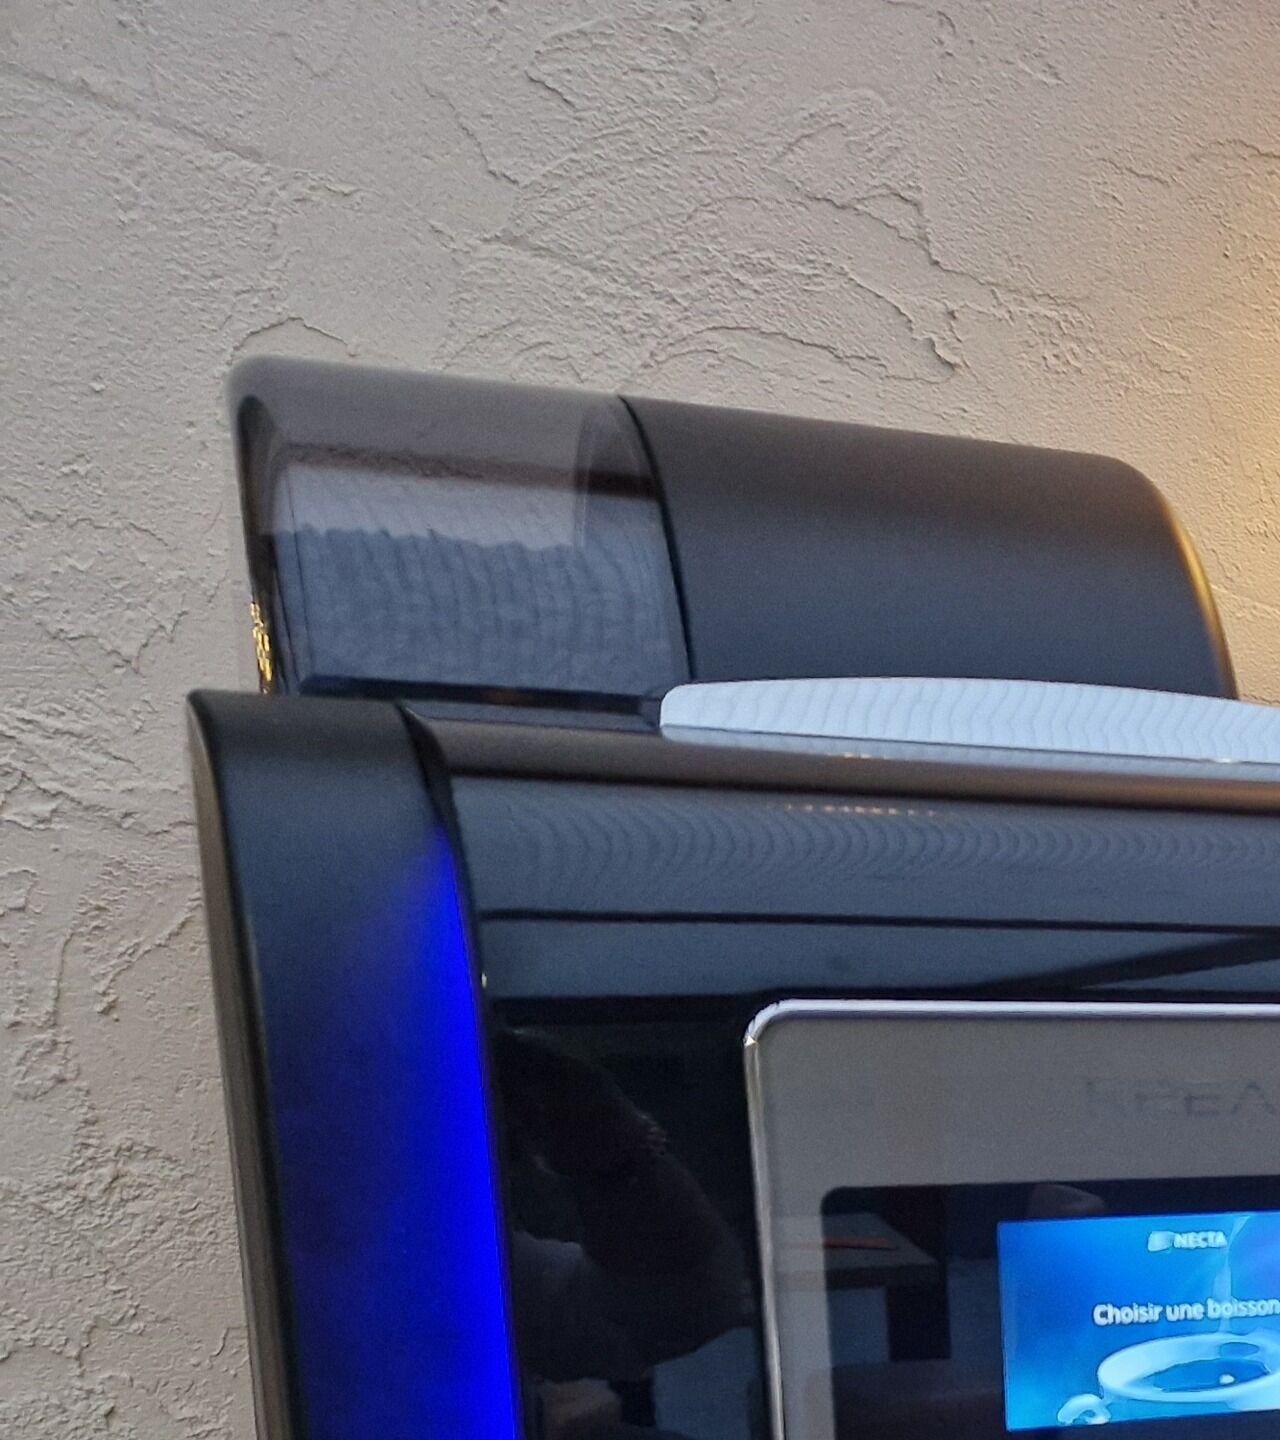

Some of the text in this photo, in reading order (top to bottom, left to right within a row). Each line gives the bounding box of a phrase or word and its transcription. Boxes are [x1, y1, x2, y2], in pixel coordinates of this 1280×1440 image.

[1173, 1231, 1228, 1249] NECTA
[1093, 1298, 1280, 1326] Choisir une boisson
